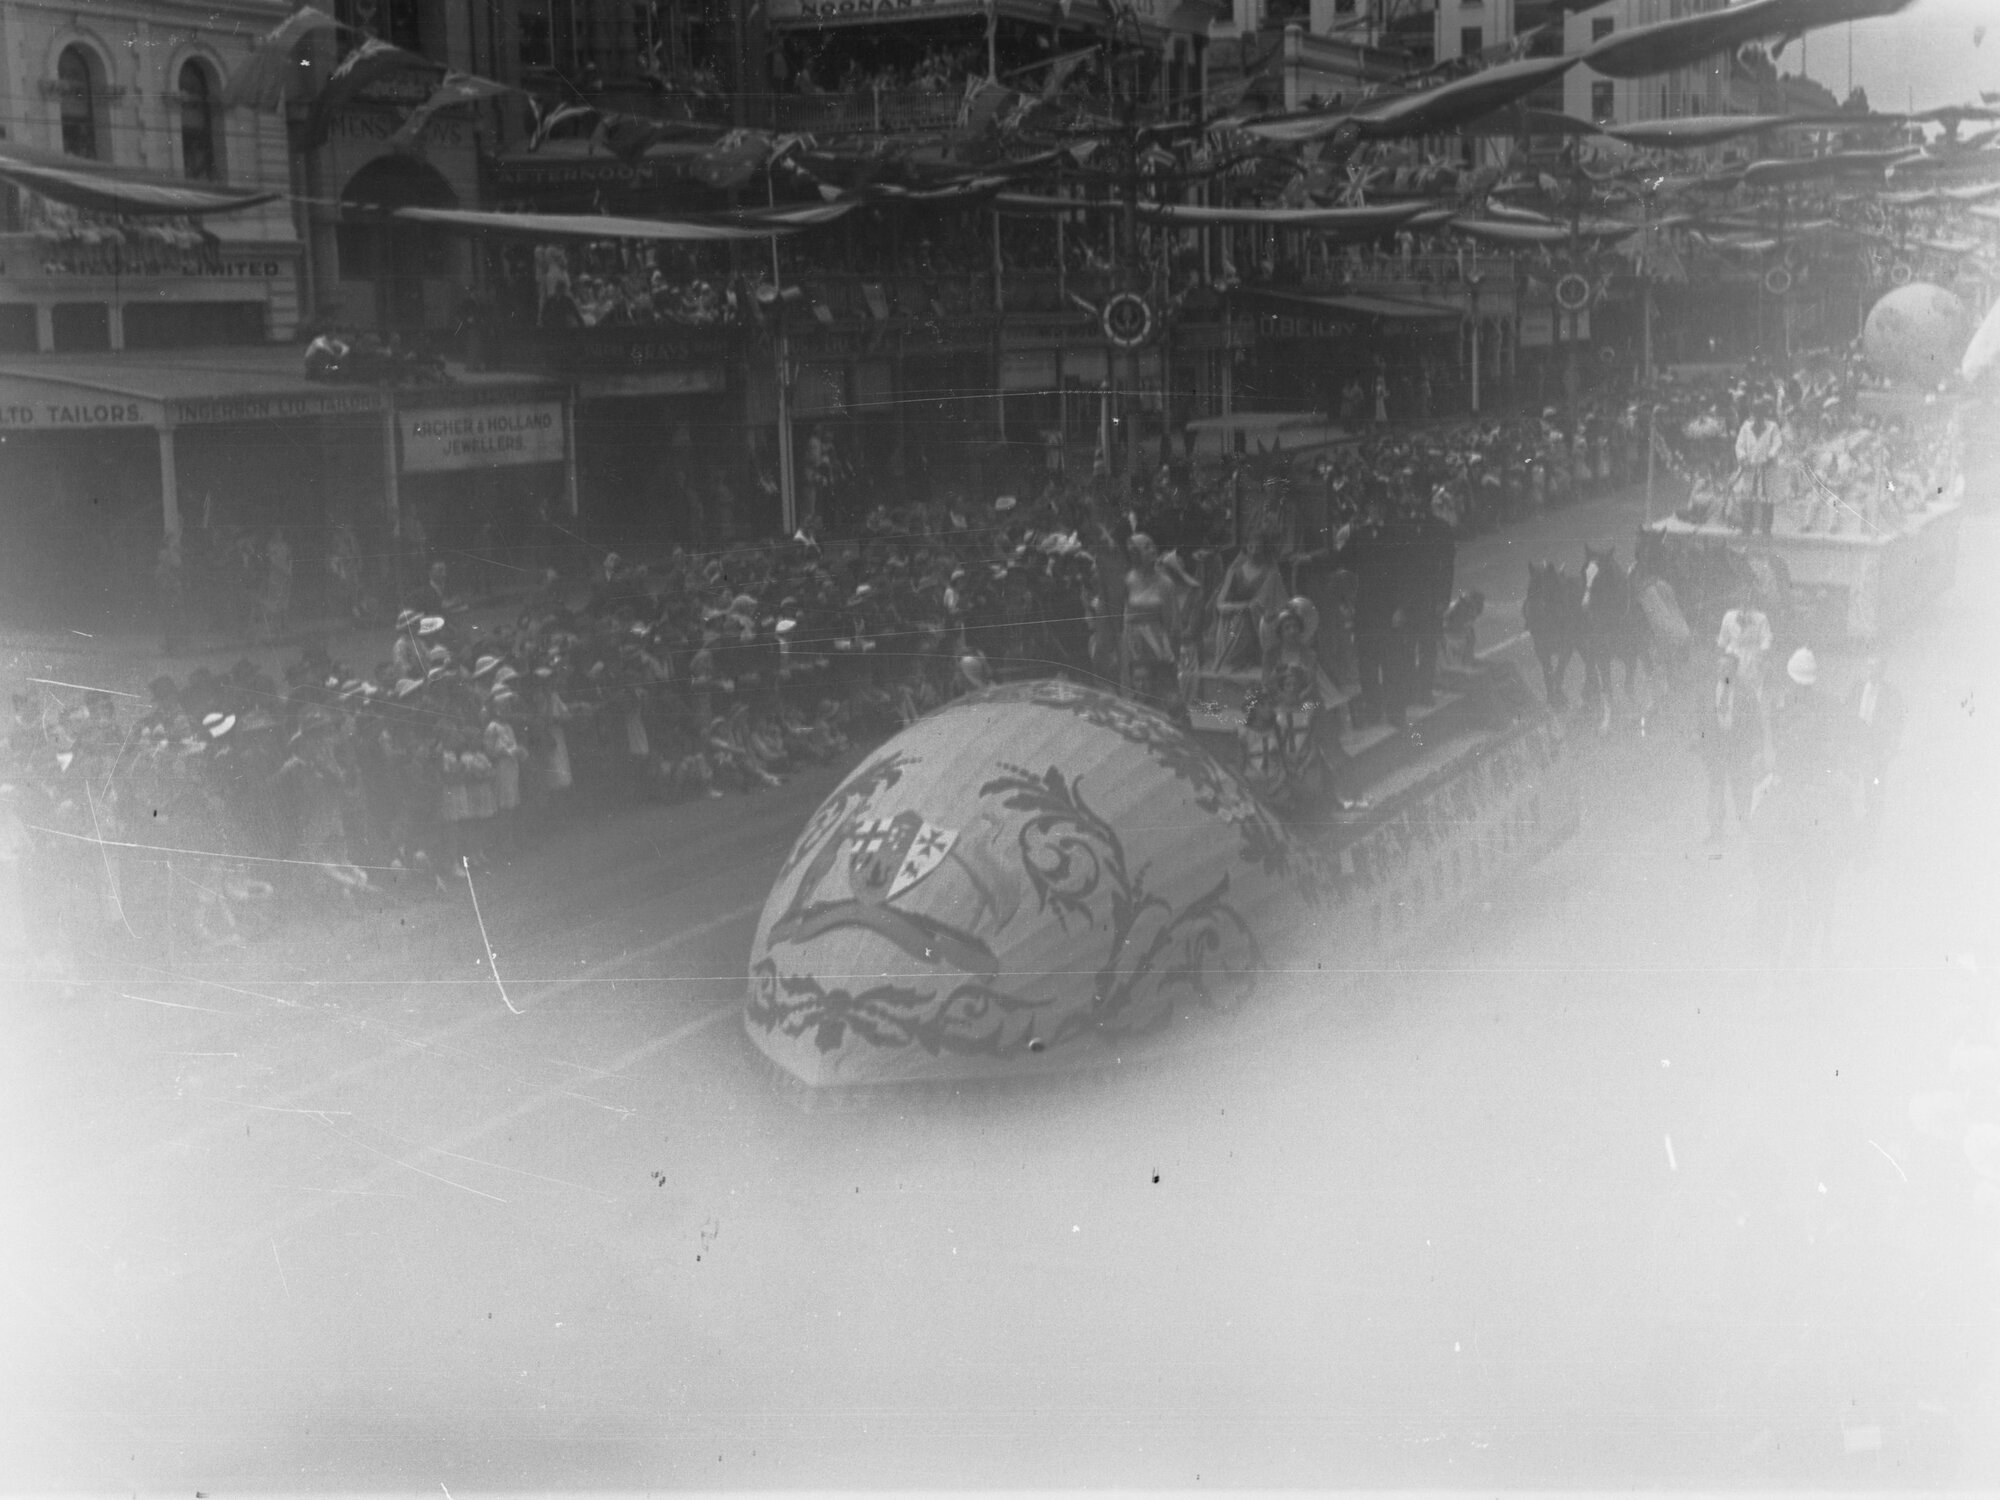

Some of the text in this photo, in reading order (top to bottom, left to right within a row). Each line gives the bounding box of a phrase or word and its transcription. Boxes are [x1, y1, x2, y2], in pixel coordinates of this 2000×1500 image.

[802, 0, 912, 15] NOONAN
[500, 163, 653, 183] AFTERNOON
[181, 260, 279, 277] LIMITED
[413, 418, 474, 437] ARCHER
[487, 413, 553, 433] HOLLAND
